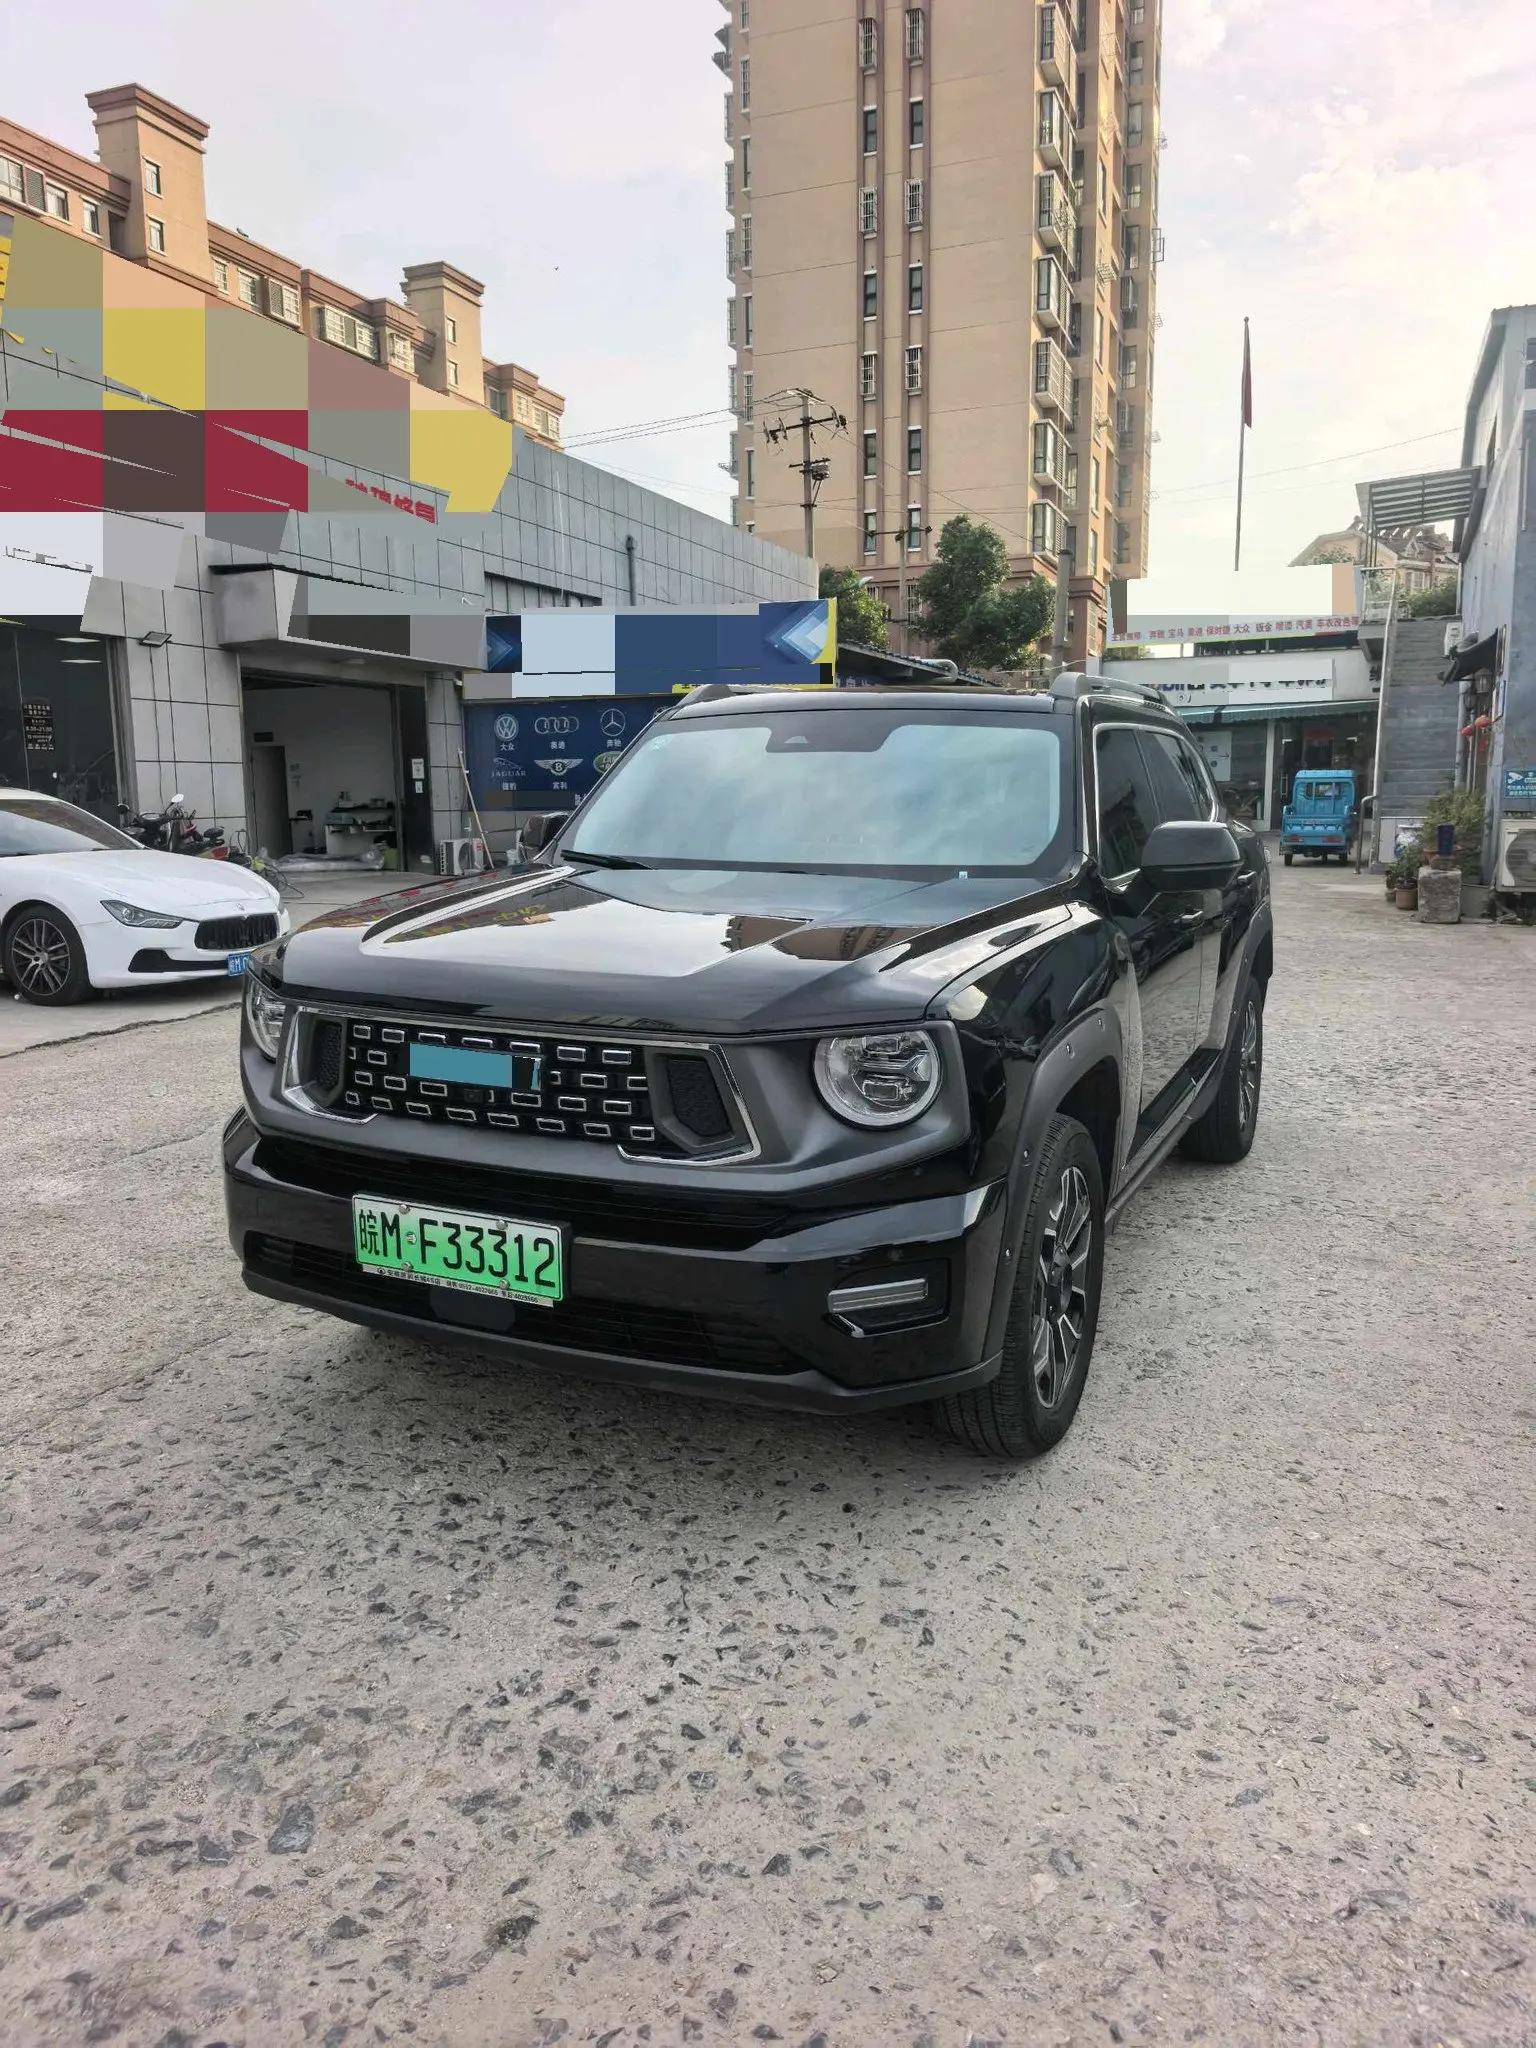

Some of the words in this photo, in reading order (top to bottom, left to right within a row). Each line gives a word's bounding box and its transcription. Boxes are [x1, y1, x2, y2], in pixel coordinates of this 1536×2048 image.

[1168, 628, 1184, 639] 宝马
[1206, 624, 1231, 636] 保时捷
[1233, 623, 1251, 635] 大众
[1255, 621, 1273, 633] 钣金
[500, 742, 515, 751] 大众
[491, 770, 526, 778] JAGUAR
